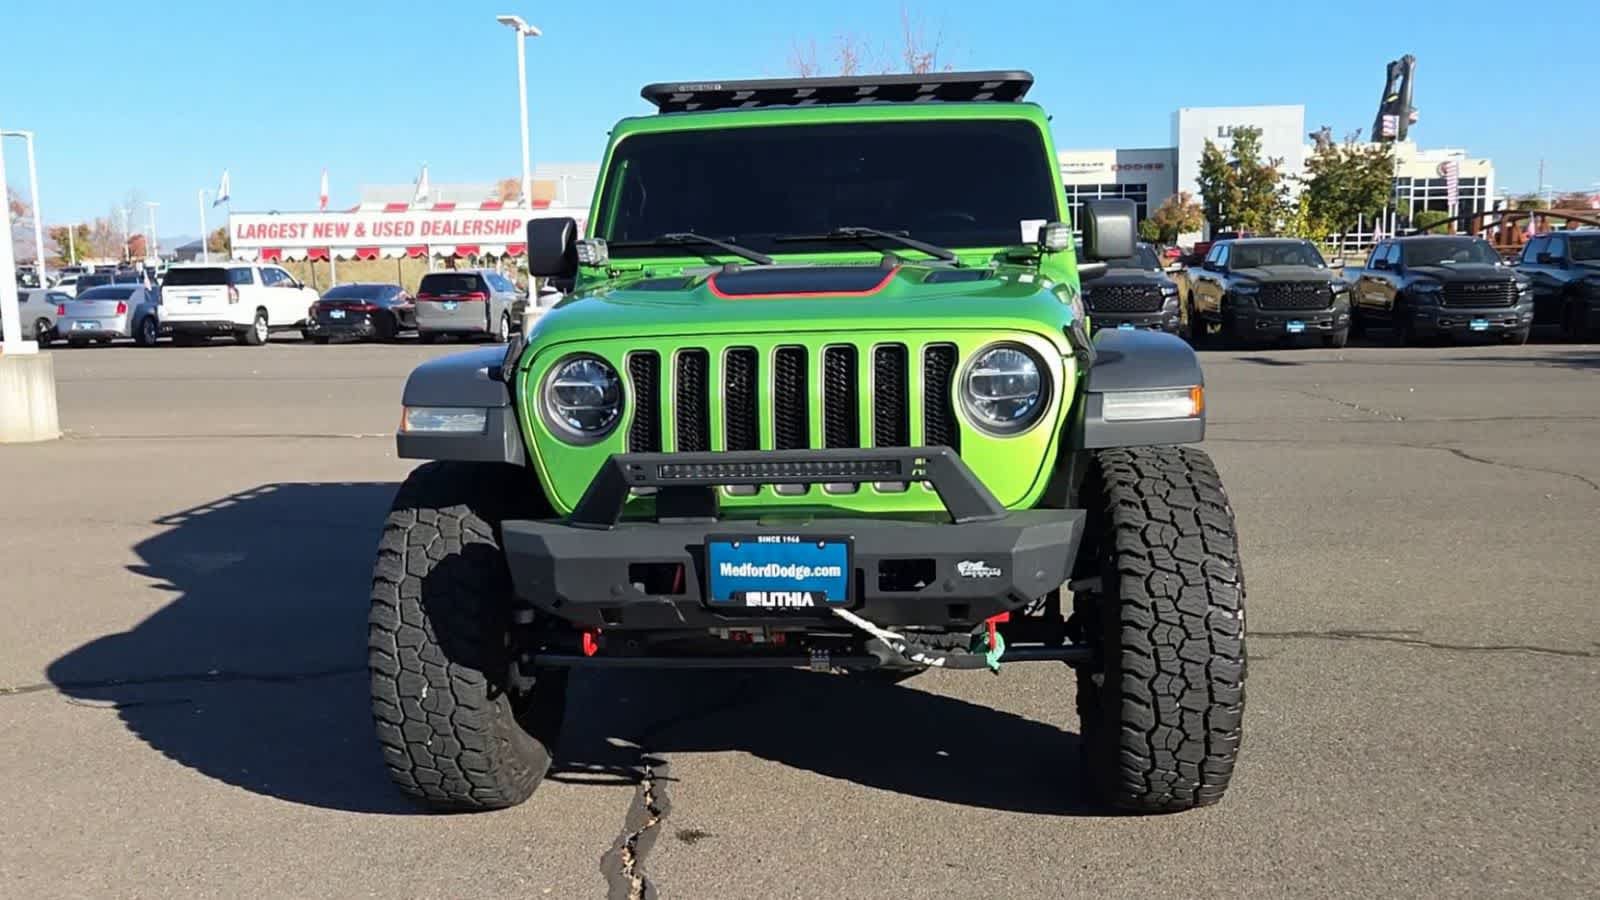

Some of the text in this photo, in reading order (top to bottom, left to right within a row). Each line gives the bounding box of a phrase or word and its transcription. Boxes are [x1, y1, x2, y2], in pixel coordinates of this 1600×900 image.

[236, 219, 522, 239] LARGEST NEW & USED DEALERSHIP
[758, 535, 781, 543] SINCE
[719, 562, 841, 580] MedfordDodge.com
[761, 591, 815, 607] LITHIA
